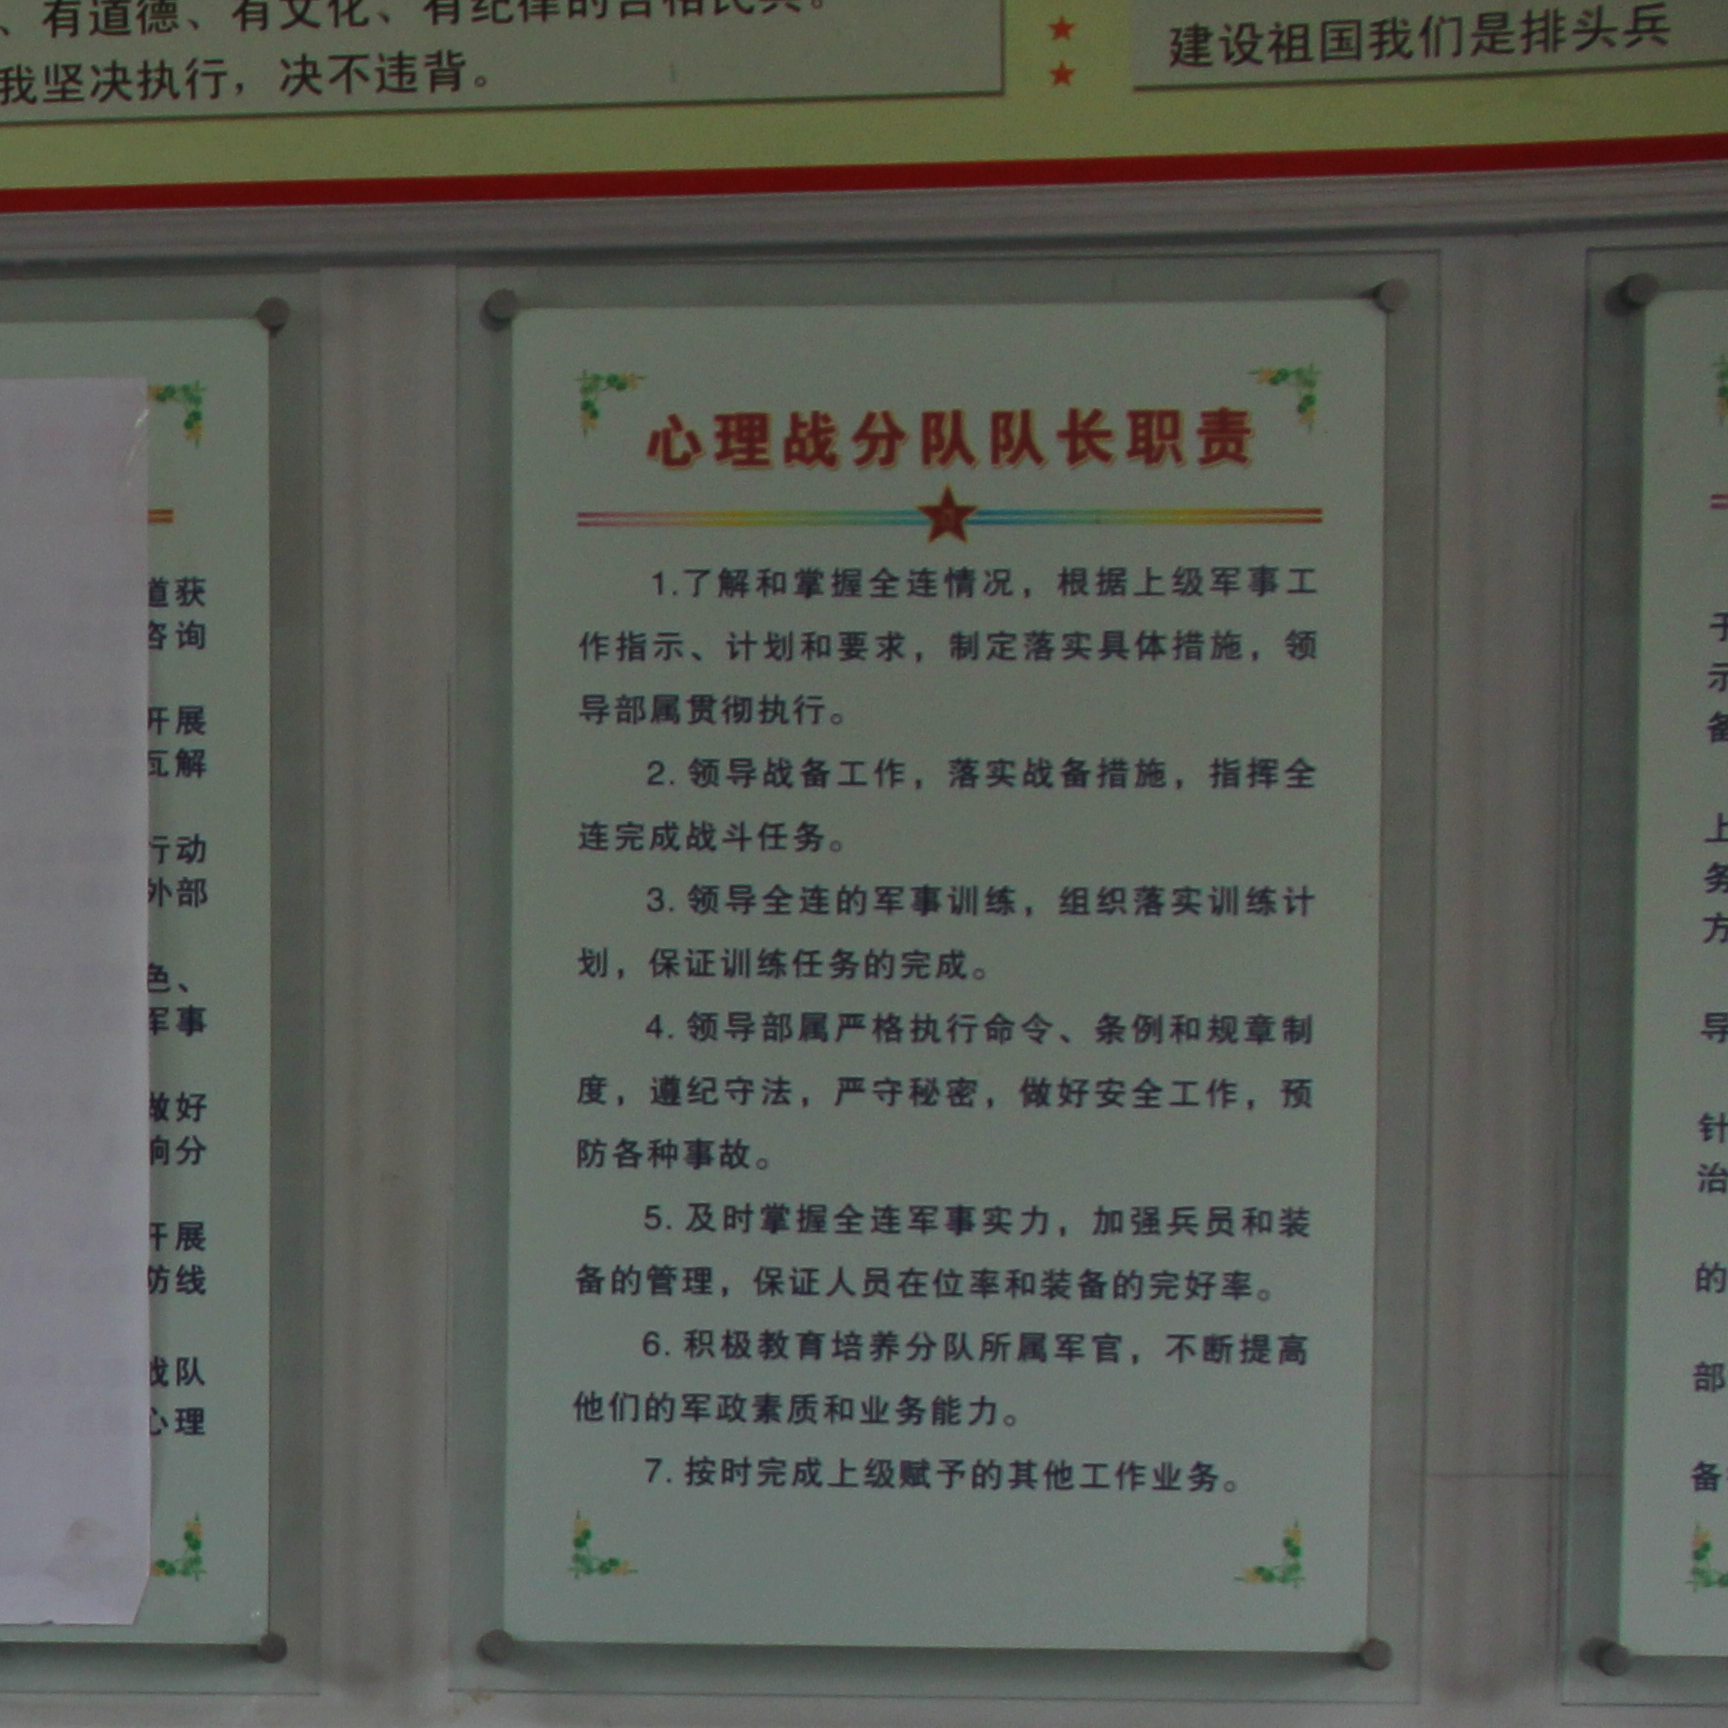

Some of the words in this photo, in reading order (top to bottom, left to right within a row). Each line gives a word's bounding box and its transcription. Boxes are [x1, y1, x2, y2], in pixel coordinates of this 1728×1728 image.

[1169, 2, 1671, 68] 建设祖国我们是排头兵
[646, 406, 1254, 471] 心理战分队队长职责
[579, 694, 843, 726] 导部属贯彻执行。
[578, 820, 842, 853] 连完成战斗任务。
[577, 947, 985, 980] 划，保证训练任务的完成。
[577, 1137, 769, 1170] 防各种事故。
[1695, 1261, 1728, 1294] 的
[1692, 1361, 1727, 1393] 部
[572, 1390, 1016, 1427] 他们的军政素质和业务能力。
